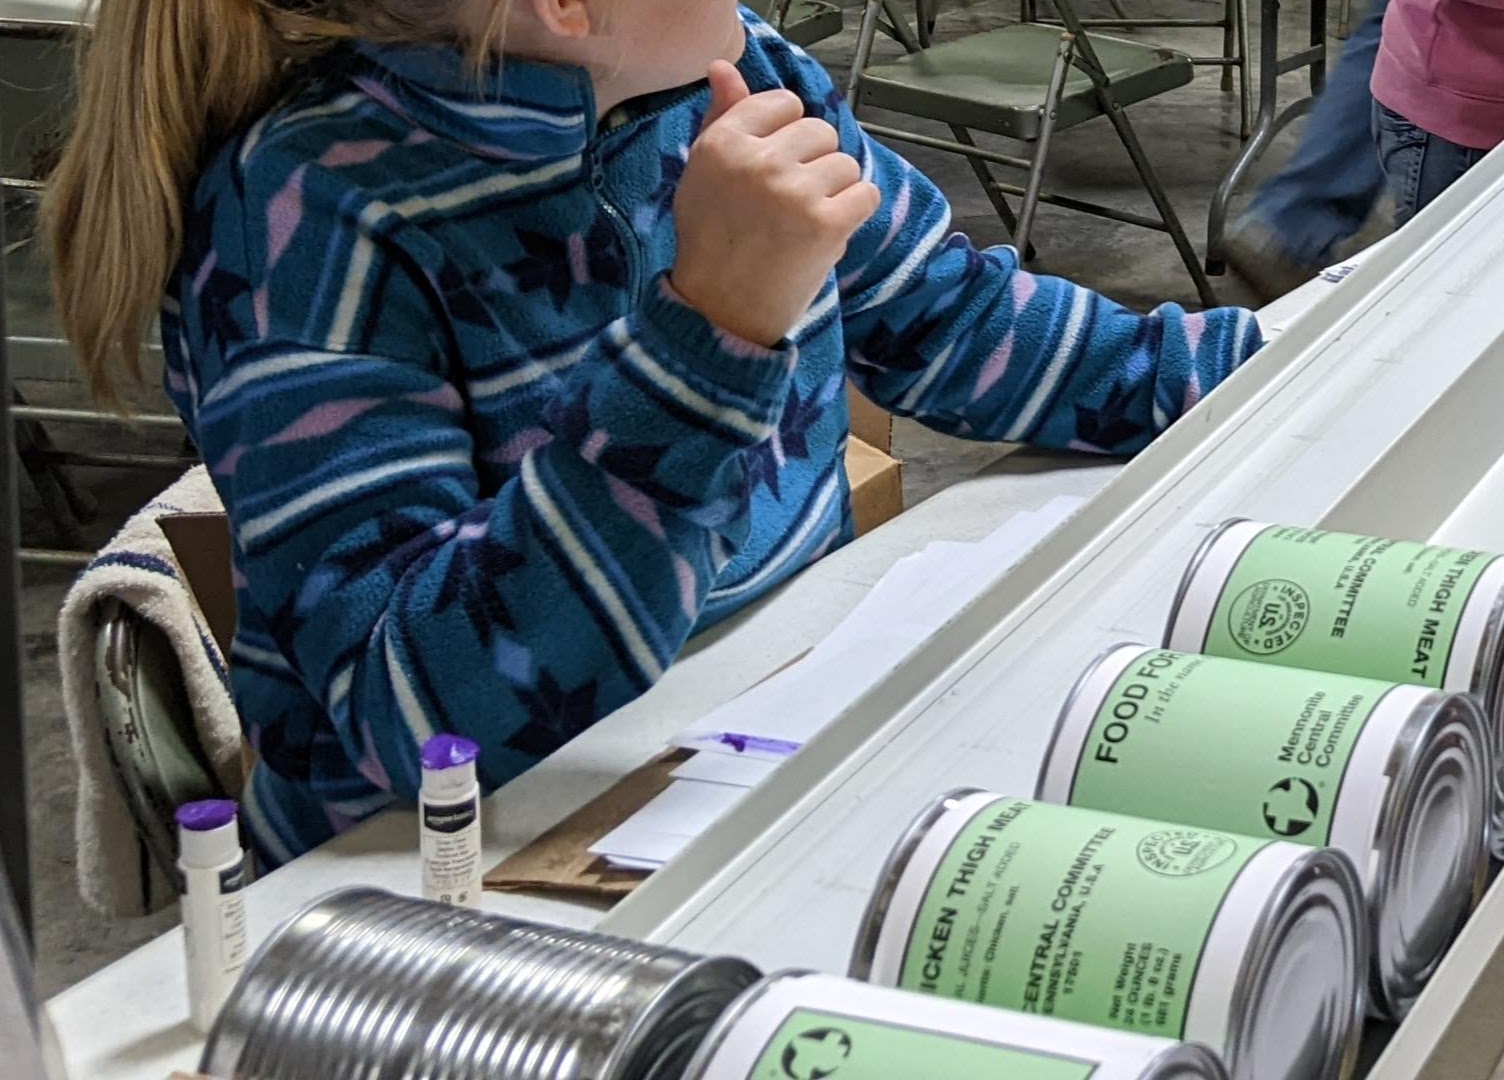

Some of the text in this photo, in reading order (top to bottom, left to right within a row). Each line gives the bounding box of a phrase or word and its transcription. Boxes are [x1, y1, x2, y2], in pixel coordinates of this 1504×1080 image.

[1263, 584, 1306, 649] INSPECTED
[1331, 557, 1377, 638] COMMITTEE
[1429, 568, 1465, 613] THIGH
[1411, 616, 1441, 680] MEAT
[1094, 683, 1149, 764] FOOD
[1144, 705, 1165, 724] In
[1157, 681, 1179, 702] the
[1278, 690, 1325, 762] Mennonite
[1315, 694, 1364, 768] Committee
[1297, 710, 1332, 765] Central
[995, 841, 1021, 879] ADDED
[1051, 826, 1116, 912] COMMITTEE
[919, 801, 1032, 994] ICKEN THIGH MEAT
[1042, 899, 1088, 1015] ENNSYLVANIA,
[1114, 942, 1137, 990] Weight
[1127, 942, 1153, 1006] OUNCES
[1163, 953, 1182, 996] grams
